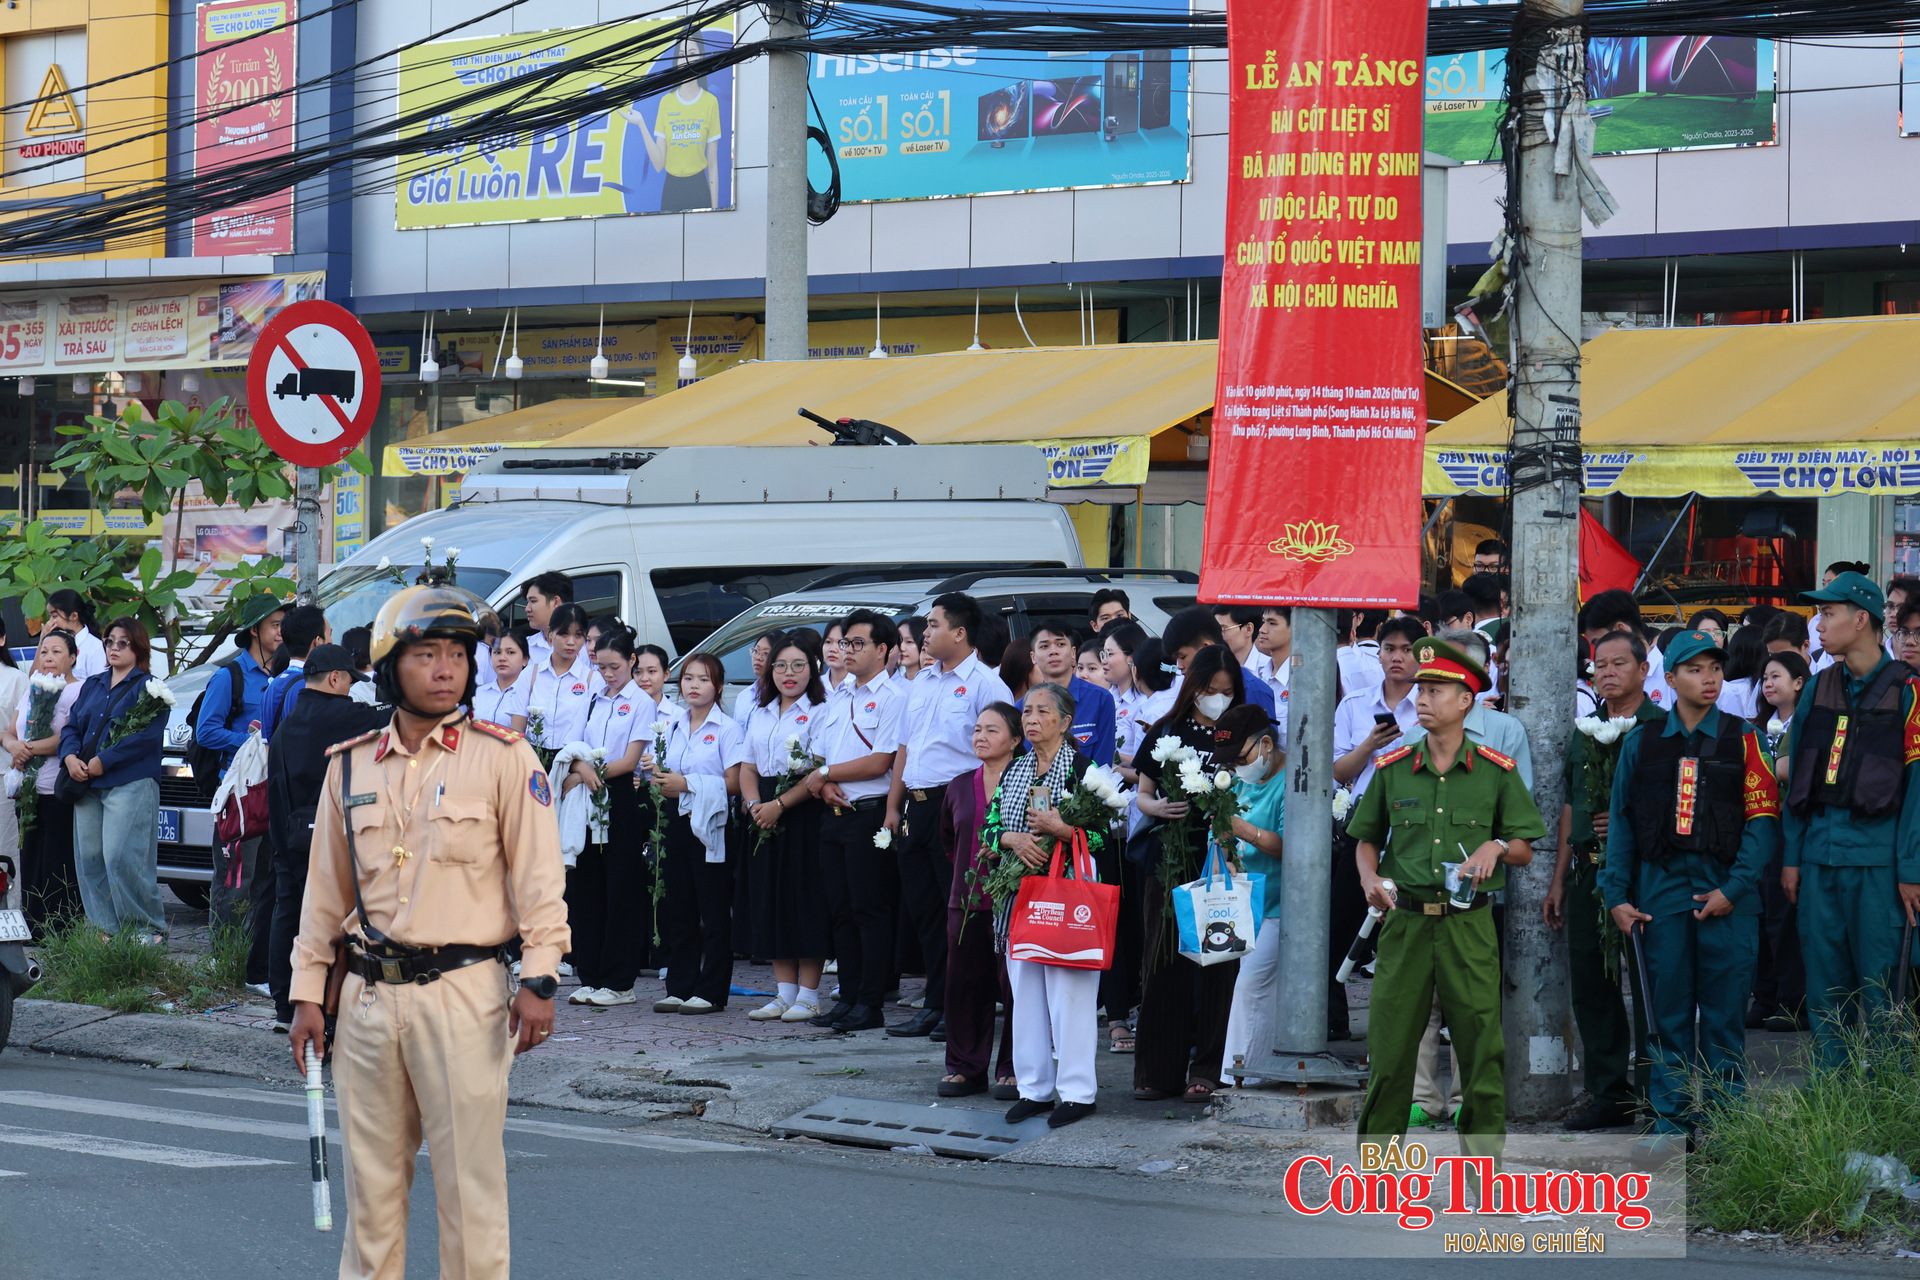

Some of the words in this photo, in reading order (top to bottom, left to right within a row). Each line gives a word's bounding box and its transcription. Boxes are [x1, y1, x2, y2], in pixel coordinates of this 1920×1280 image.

[470, 55, 483, 66] THỊ
[485, 51, 503, 65] ĐIỆN
[1245, 50, 1280, 90] LỄ
[1285, 60, 1323, 88] AN
[1331, 53, 1419, 87] TÁNG
[218, 76, 271, 109] 2001
[839, 96, 857, 107] TOÀN
[858, 94, 873, 105] CẦU
[900, 91, 919, 101] TOÀN
[920, 89, 935, 100] CẦU
[1444, 100, 1466, 111] Laser
[1467, 99, 1478, 109] TV
[1271, 105, 1293, 134] HÀI
[1298, 99, 1327, 132] CỐT
[1331, 103, 1368, 137] LIỆT
[1372, 103, 1391, 132] SĨ
[18, 143, 44, 158] CAO
[44, 140, 86, 156] PHONG
[873, 146, 882, 155] TV
[906, 142, 914, 152] về
[915, 142, 934, 151] Laser
[934, 141, 944, 150] TV
[1242, 150, 1264, 178] ĐÃ
[1267, 153, 1296, 178] ANH
[1300, 147, 1344, 176] DŨNG
[1350, 153, 1372, 176] HY
[1377, 153, 1419, 176] SINH
[407, 165, 454, 206] Giá
[456, 162, 522, 204] Luôn
[1259, 193, 1272, 221] VÌ
[1273, 191, 1306, 225] ĐỘC
[1309, 190, 1341, 225] LẬP,
[1347, 194, 1372, 225] TỰ
[1374, 196, 1398, 220] DO
[1237, 233, 1264, 265] CỦA
[1267, 230, 1287, 264] TỔ
[1290, 231, 1332, 266] QUỐC
[1337, 235, 1375, 269] VIỆT
[1379, 241, 1421, 265] NAM
[1249, 279, 1268, 308] XÃ
[1273, 278, 1300, 313] HỘI
[1305, 275, 1338, 308] CHỦ
[1342, 279, 1399, 309] NGHĨA
[135, 302, 161, 316] HOÀN
[58, 321, 76, 336] XÀI
[79, 317, 115, 334] TRƯỚC
[131, 319, 159, 333] CHÊNH
[160, 316, 183, 332] LỆCH
[23, 336, 43, 348] NGÀY
[63, 337, 83, 356] TRẢ
[86, 340, 107, 354] SAU
[542, 335, 558, 350] SẢN
[559, 334, 581, 349] PHẨM
[582, 336, 594, 347] ĐA
[808, 347, 821, 358] THỊ
[823, 345, 845, 359] ĐIỆN
[846, 343, 865, 356] MÁY
[537, 354, 557, 366] THOẠI
[1245, 385, 1254, 397] 10
[1267, 385, 1275, 397] 00
[1275, 385, 1294, 400] phút,
[1294, 385, 1310, 401] ngày
[1311, 386, 1321, 398] 14
[1321, 385, 1344, 401] tháng
[1345, 386, 1354, 398] 10
[1355, 386, 1371, 399] năm
[1372, 387, 1391, 399] 2026
[1251, 405, 1270, 420] trang
[1271, 404, 1285, 420] Liệt
[1292, 404, 1312, 417] Thành
[1313, 403, 1328, 420] phố
[1328, 405, 1349, 421] (Song
[1350, 405, 1369, 418] Hành
[1370, 406, 1380, 419] Xa
[1381, 406, 1390, 422] Lộ
[1390, 405, 1401, 419] Hà
[1401, 406, 1416, 422] Nội,
[1232, 423, 1246, 436] Khu
[1246, 422, 1261, 439] phố
[1268, 424, 1294, 440] phường
[1295, 424, 1311, 440] Long
[1312, 424, 1331, 439] Bình,
[1332, 425, 1355, 438] Thành
[1355, 424, 1371, 441] phố
[1371, 424, 1382, 438] Hồ
[1382, 425, 1395, 439] Chí
[1395, 426, 1416, 441] Minh)
[1069, 442, 1090, 459] NỘI
[1092, 440, 1119, 456] THẤT
[1436, 450, 1466, 464] SIÊU
[1468, 452, 1490, 466] THỊ
[1599, 449, 1634, 464] THẤT
[1734, 449, 1767, 464] SIÊU
[1770, 452, 1794, 466] THỊ
[1797, 449, 1832, 466] ĐIỆN
[1835, 447, 1868, 464] MÁY
[1882, 446, 1910, 466] NỘI
[422, 455, 449, 472] CHỢ
[1783, 465, 1838, 493] CHỢ
[1842, 459, 1898, 488] LỚN
[196, 527, 204, 536] LG
[1828, 718, 1848, 782] DQTV
[1680, 766, 1693, 828] DQTV
[1208, 906, 1231, 919] Cool
[0, 925, 28, 938] 3.03
